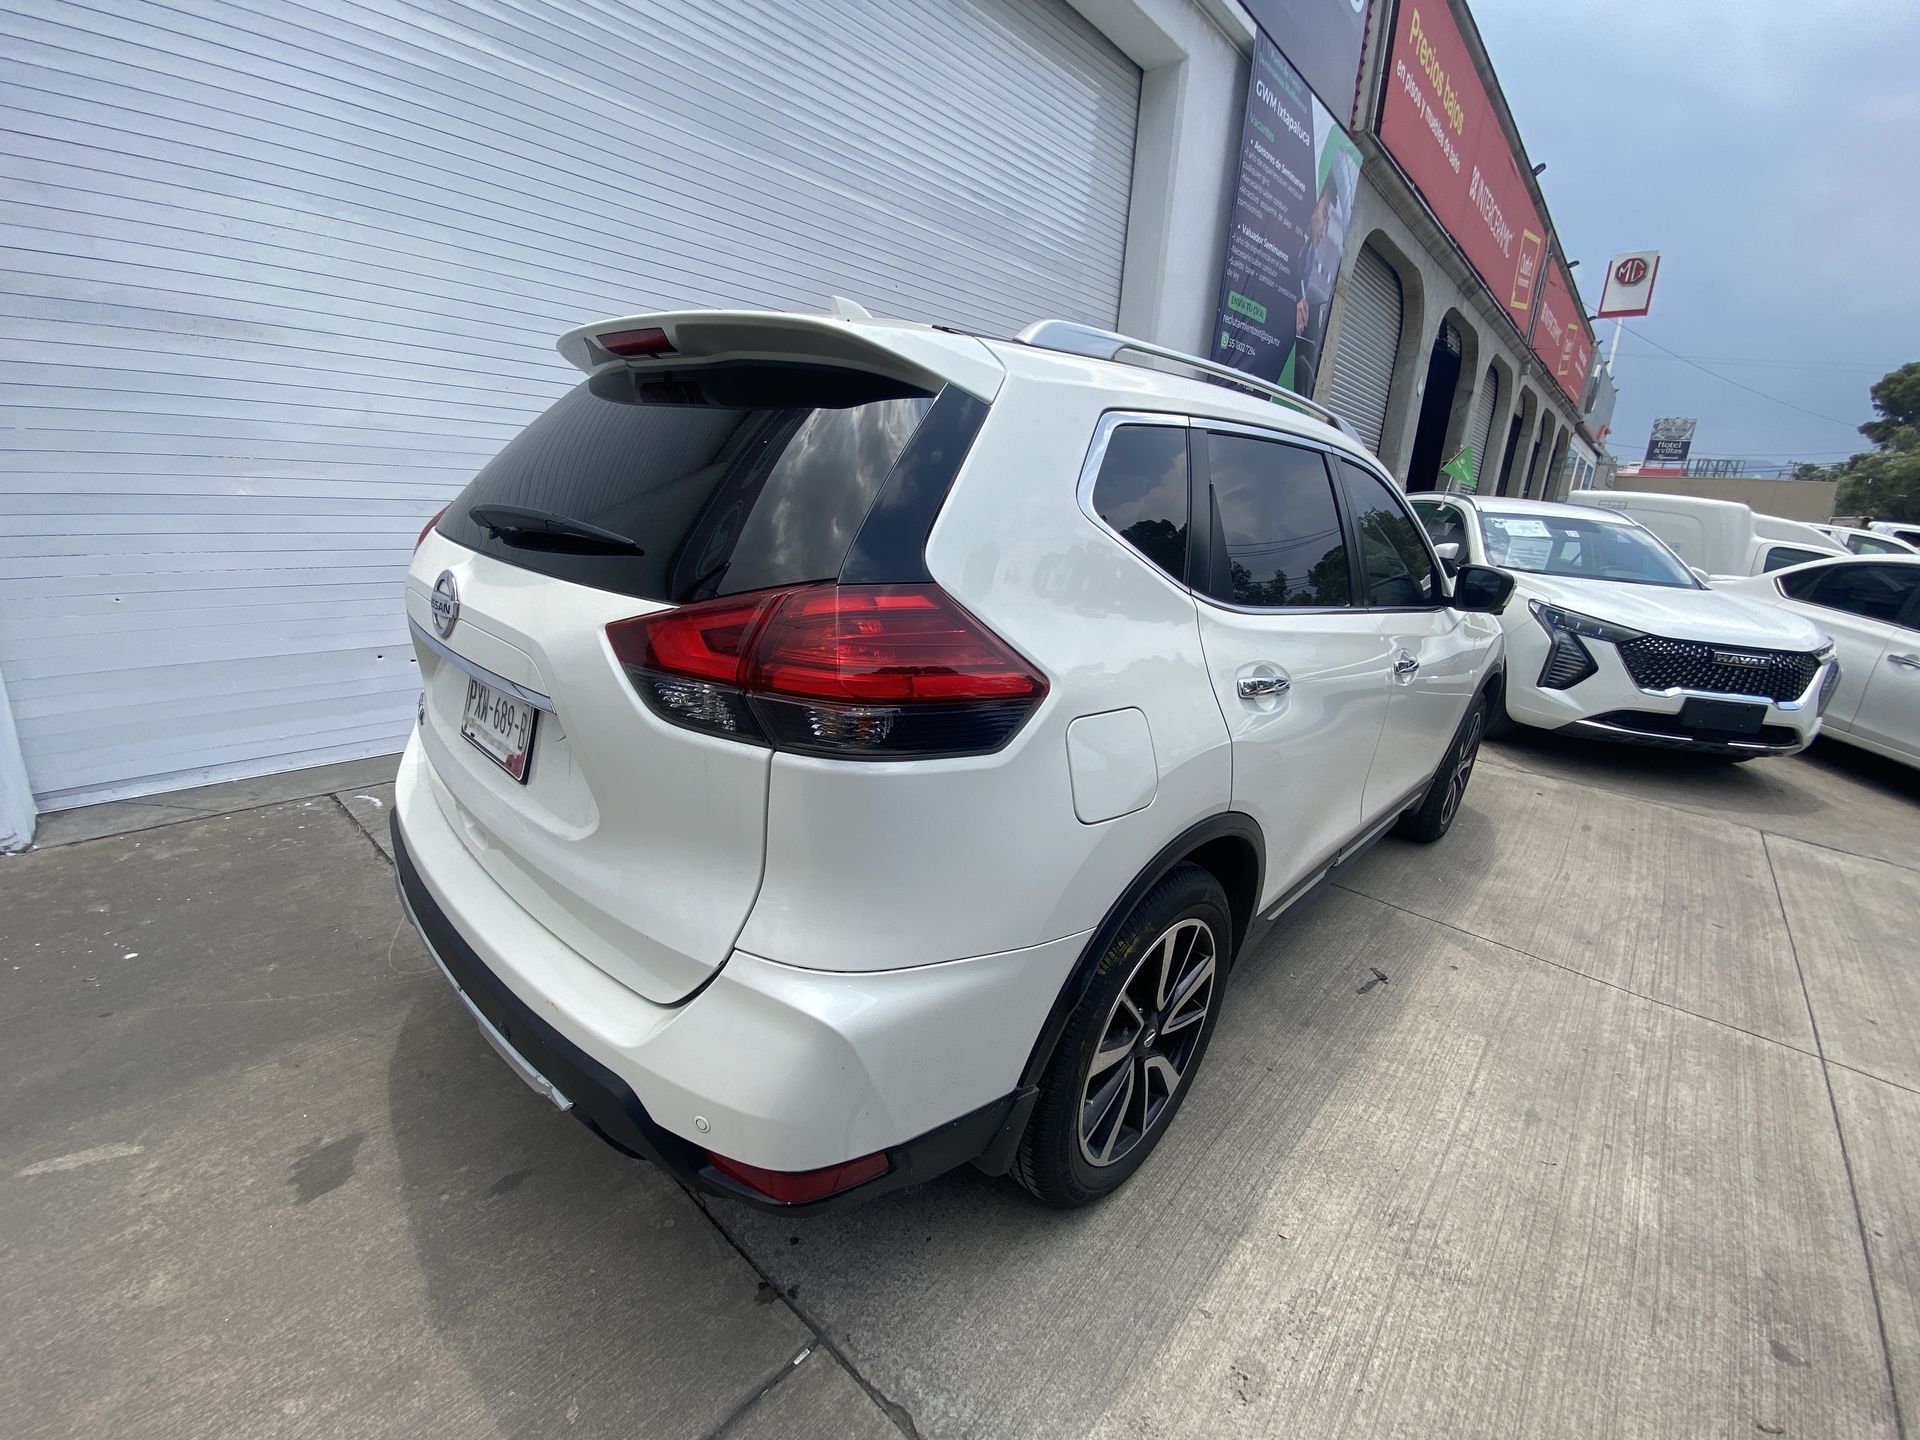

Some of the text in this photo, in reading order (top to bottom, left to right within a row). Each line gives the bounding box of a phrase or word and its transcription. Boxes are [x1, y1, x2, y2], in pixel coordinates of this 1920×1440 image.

[1409, 8, 1464, 136] Precios bajos
[1250, 113, 1274, 142] Vacantes
[1256, 80, 1310, 147] GWM Ixtapaluca
[1396, 59, 1406, 82] en
[1404, 73, 1422, 108] pisos
[1420, 98, 1426, 118] y
[1425, 105, 1444, 148] muebles
[1254, 140, 1306, 192] Asesores de Seminuevos
[1241, 223, 1289, 262] Valuador Seminuevos
[1476, 178, 1514, 258] INTERCERAMIC
[1618, 260, 1645, 282] MG
[1246, 302, 1252, 313] TU
